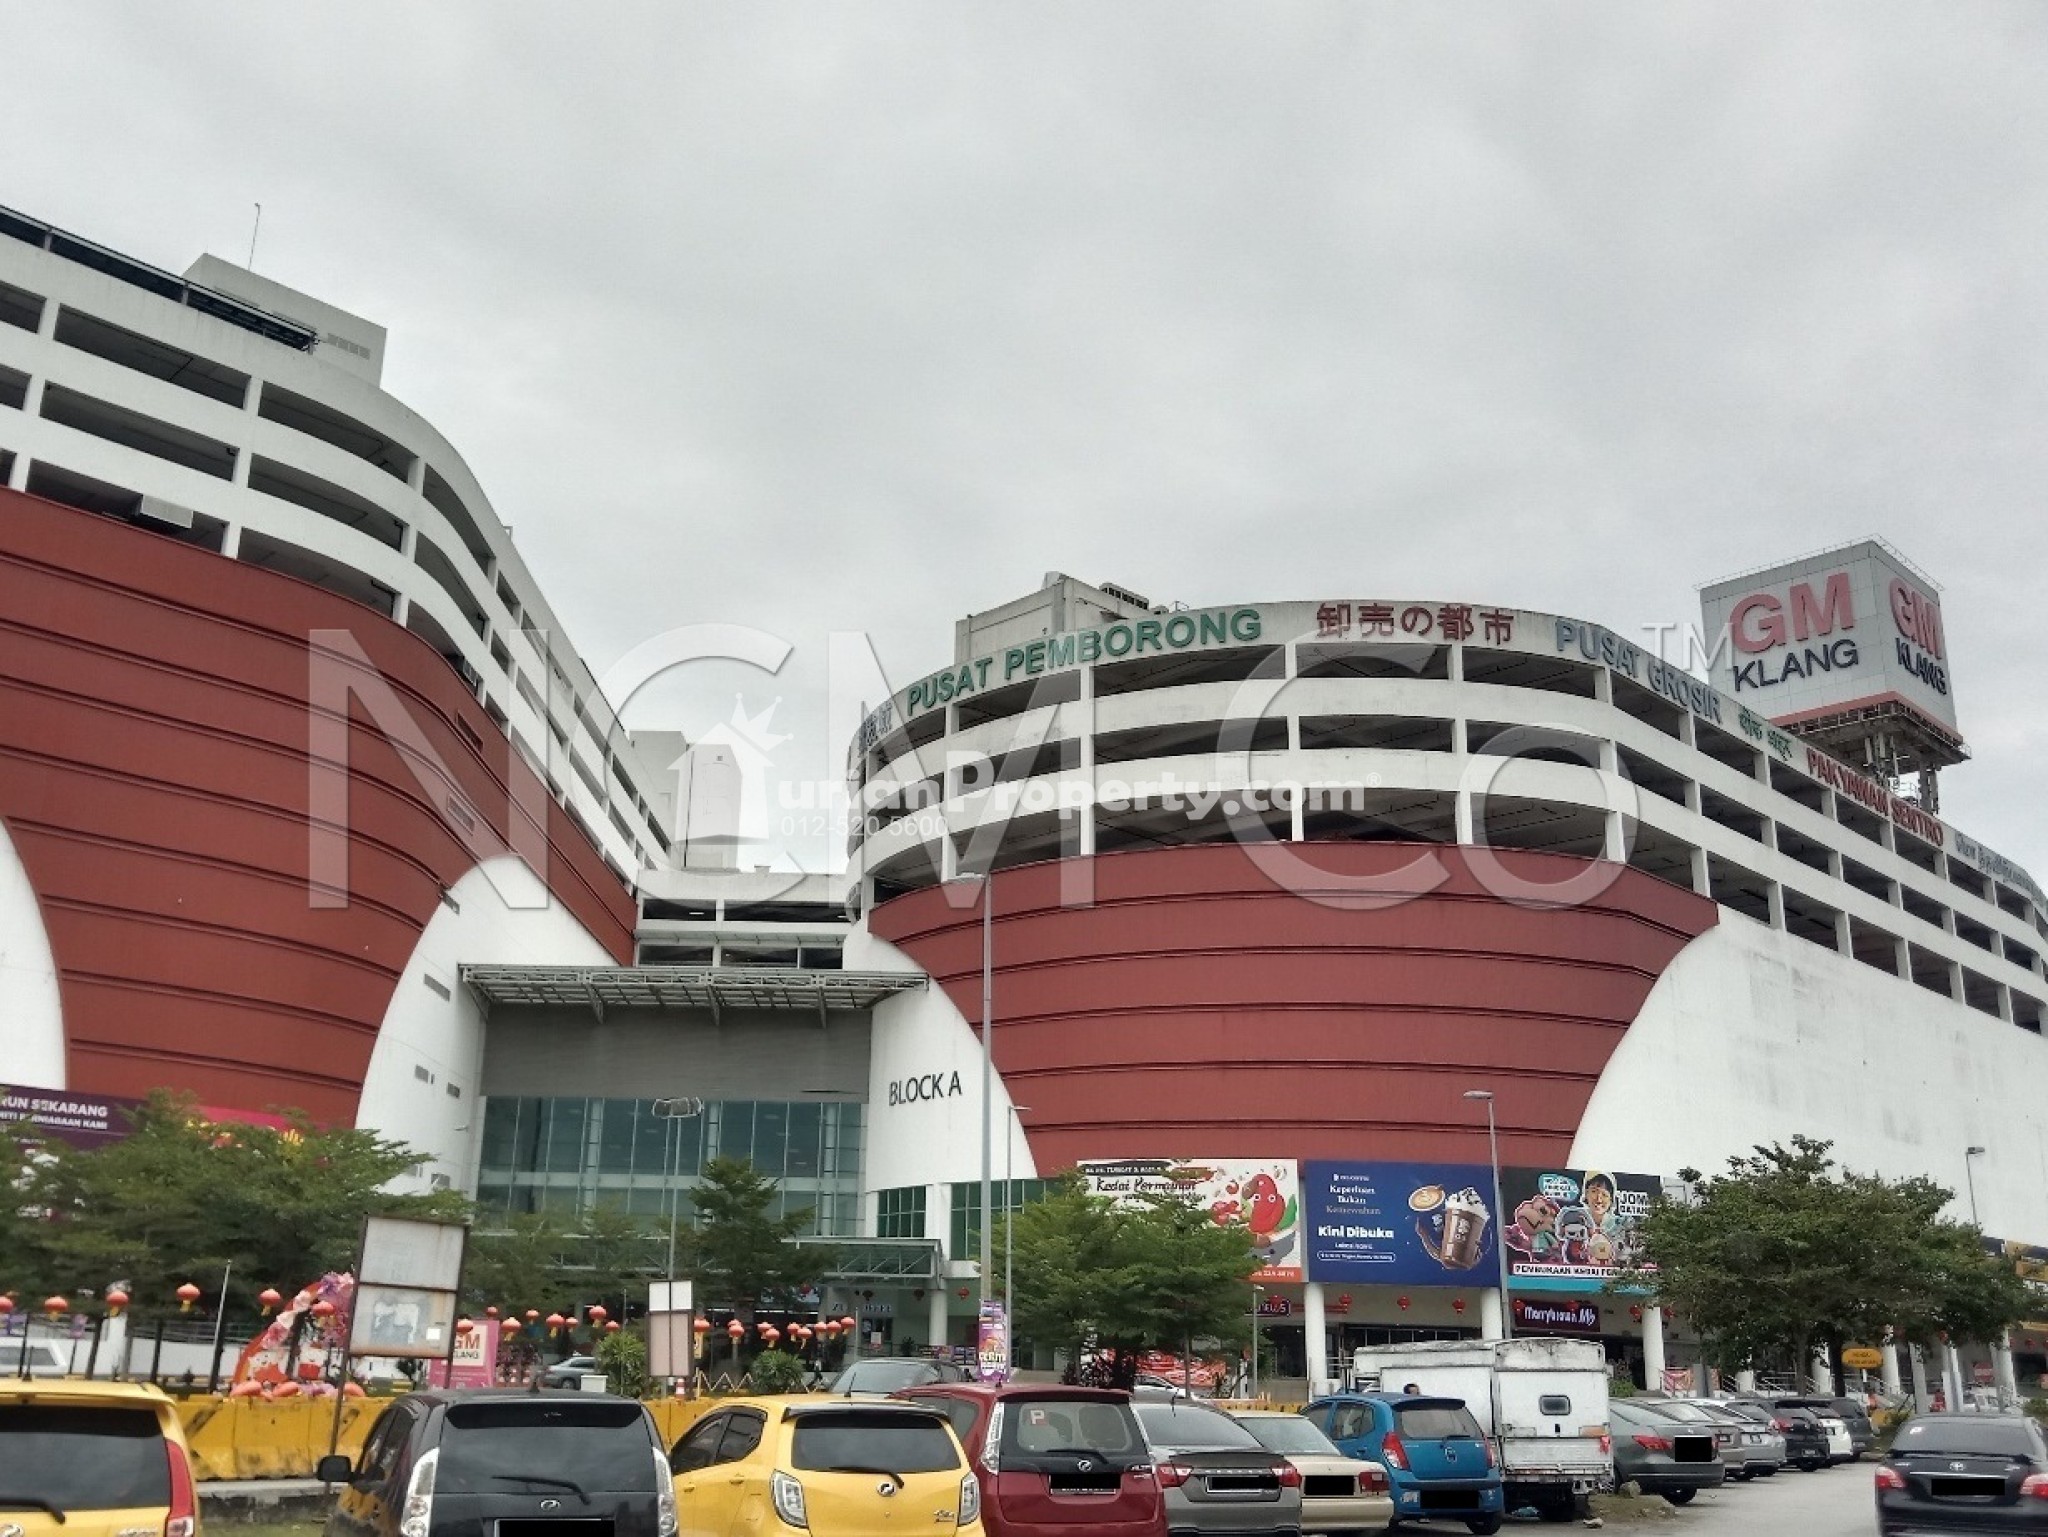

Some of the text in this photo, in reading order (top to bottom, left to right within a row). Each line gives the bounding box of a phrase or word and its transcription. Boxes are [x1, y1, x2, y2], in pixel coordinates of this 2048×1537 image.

[1729, 572, 1855, 655] GM
[1888, 577, 1942, 661] GM
[906, 609, 1262, 717] PUSAT PEMBORONG
[1553, 619, 1724, 725] PUSAT GROSIR
[1732, 639, 1859, 692] KLANG
[1895, 637, 1946, 696] KLANG
[888, 1070, 963, 1107] BLOCK A
[1318, 1225, 1395, 1239] Kini Dibuka
[1030, 1409, 1045, 1425] P
